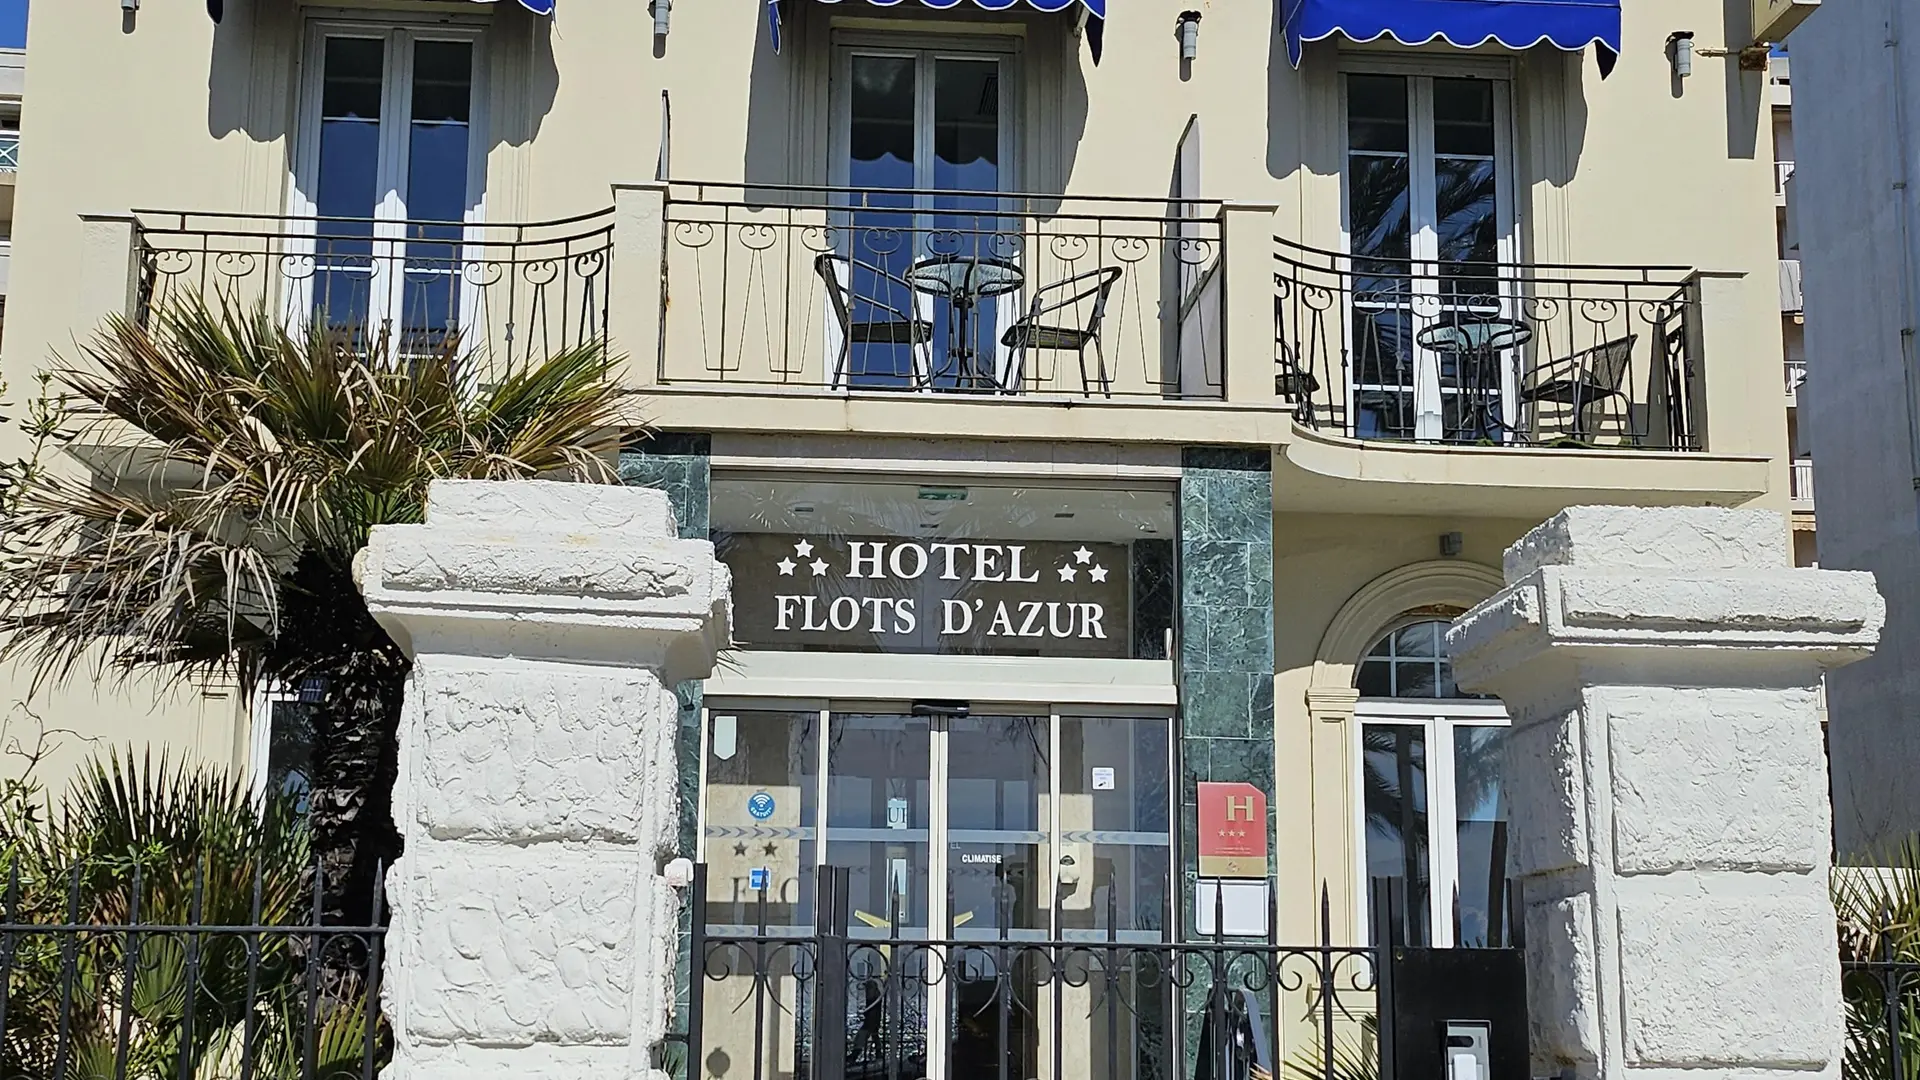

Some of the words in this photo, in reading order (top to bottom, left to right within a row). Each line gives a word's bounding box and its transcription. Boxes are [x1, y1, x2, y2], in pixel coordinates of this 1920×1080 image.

[846, 541, 1039, 583] HOTEL
[774, 595, 916, 634] FLOTS
[941, 599, 1108, 639] D'AZUR
[750, 806, 772, 818] GRATUIT
[1226, 795, 1255, 822] H
[961, 853, 1002, 864] CLIMATISE
